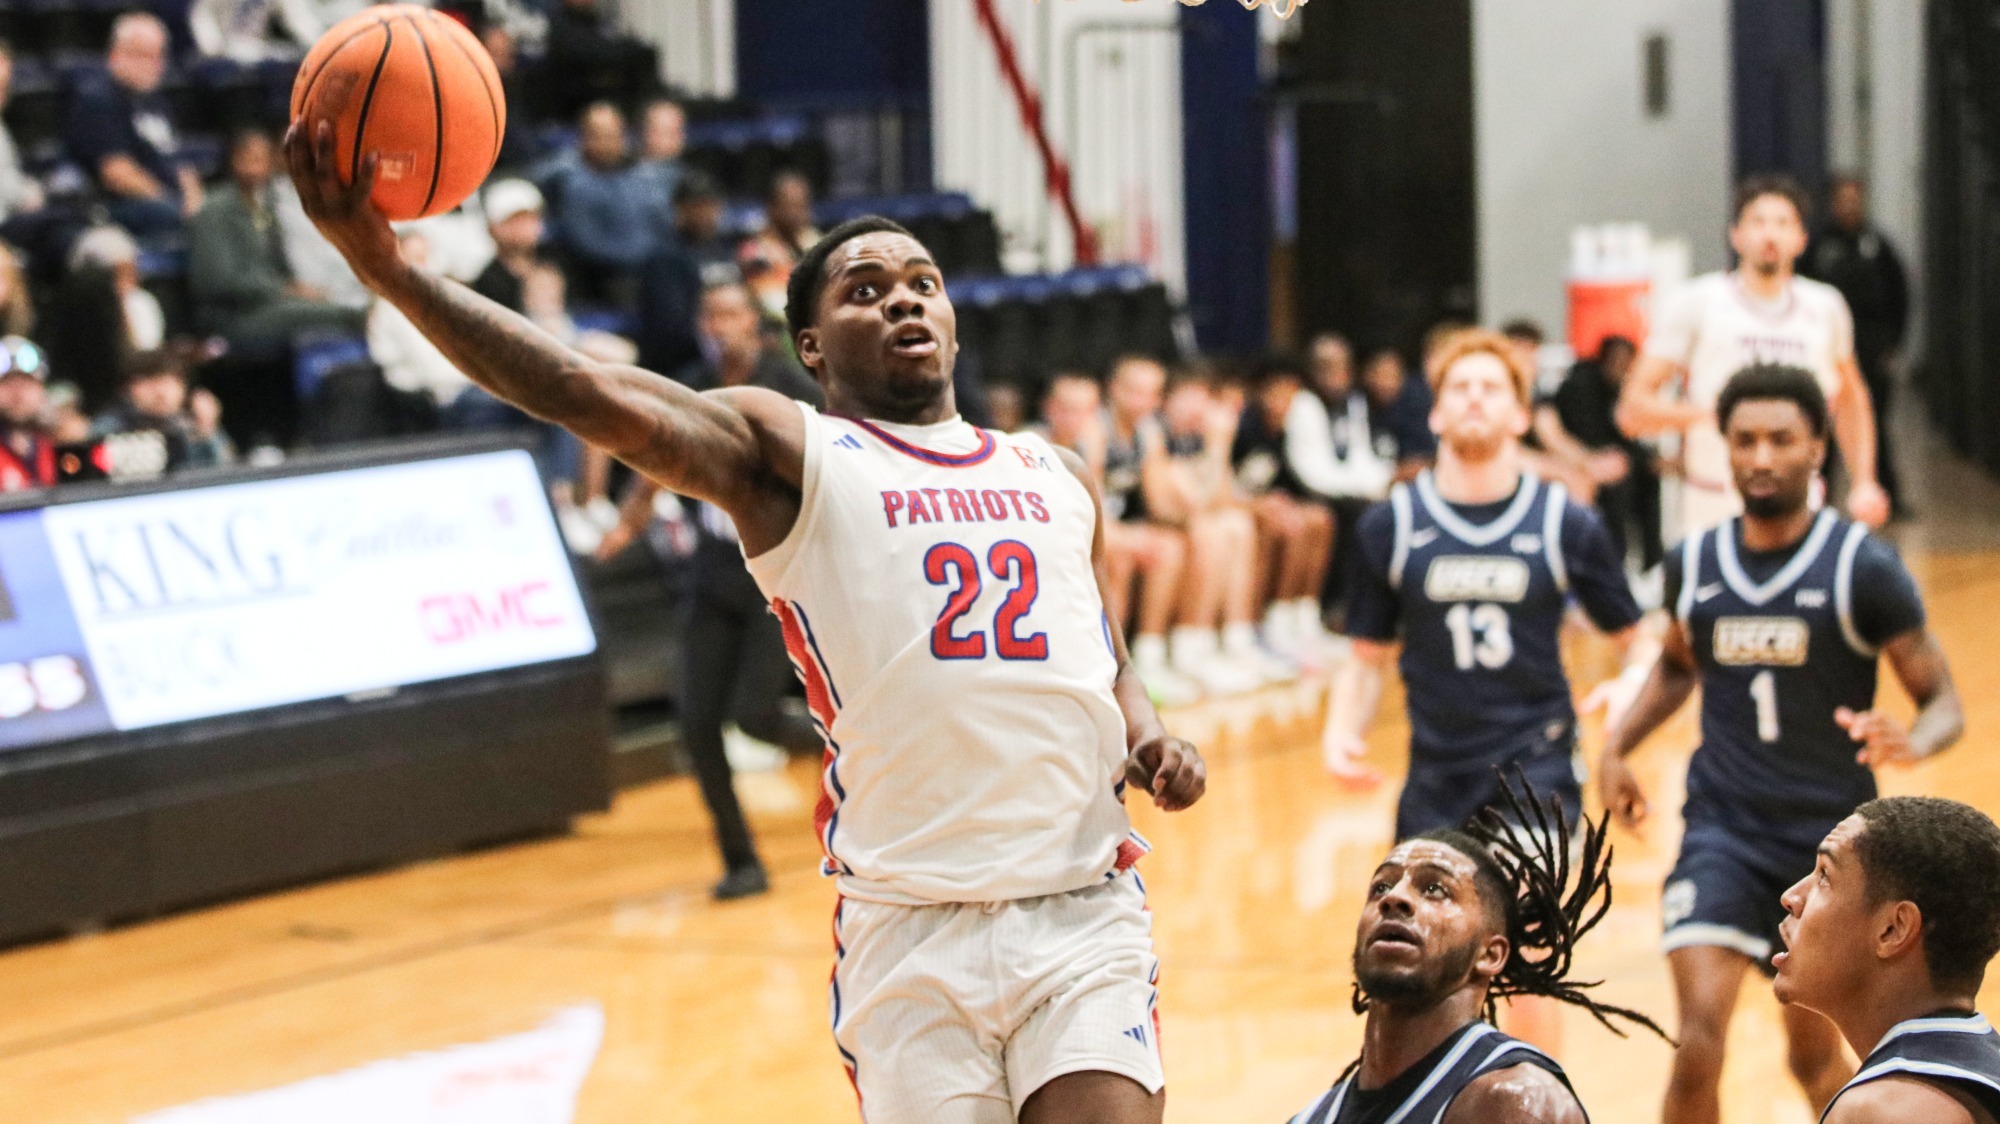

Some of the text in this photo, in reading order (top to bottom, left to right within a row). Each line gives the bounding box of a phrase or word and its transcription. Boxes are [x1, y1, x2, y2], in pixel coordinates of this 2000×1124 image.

[880, 488, 1051, 528] PATRIOTS
[71, 505, 285, 612] KING
[419, 580, 566, 645] GMC
[923, 539, 1049, 661] 22
[1445, 603, 1514, 670] 13
[1750, 671, 1780, 742] 1
